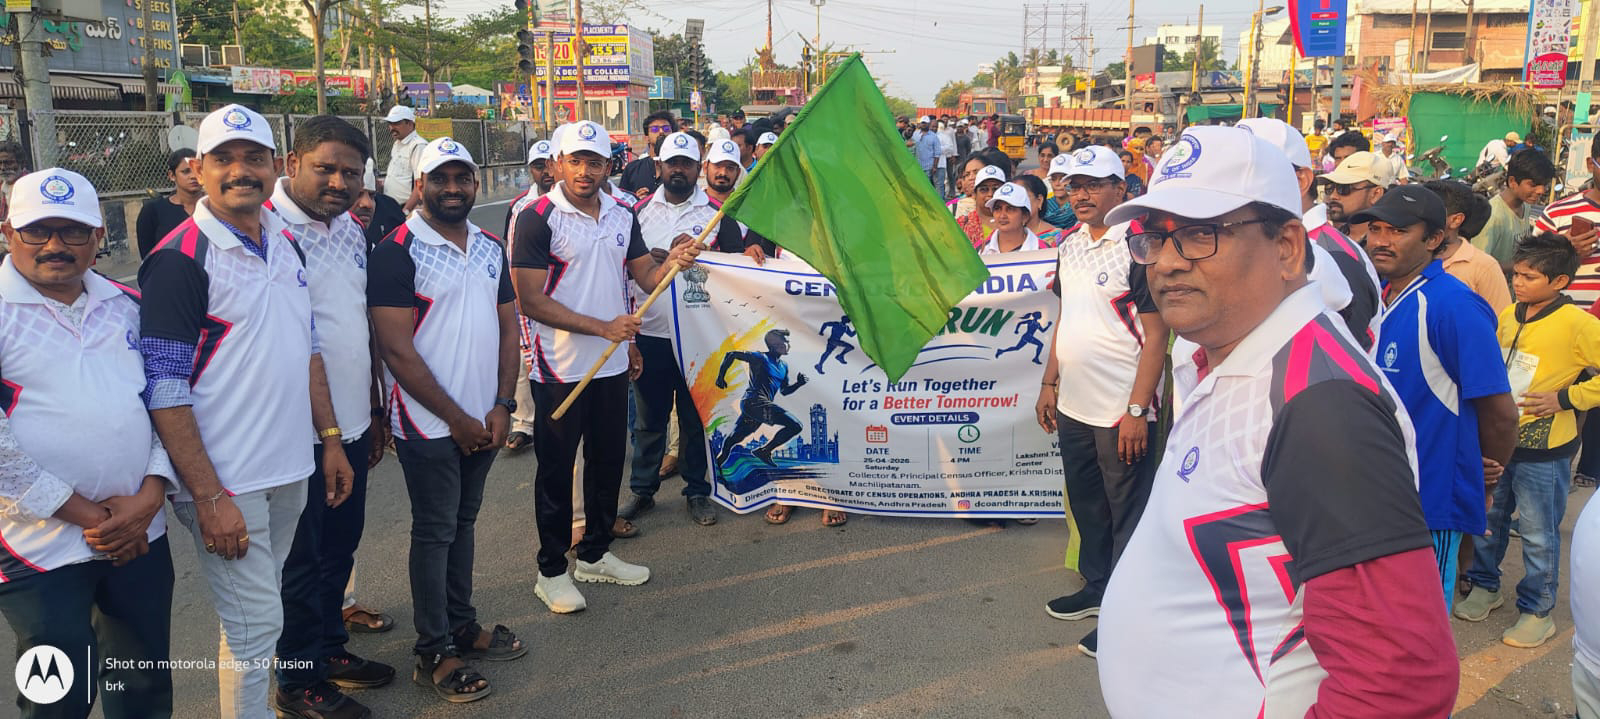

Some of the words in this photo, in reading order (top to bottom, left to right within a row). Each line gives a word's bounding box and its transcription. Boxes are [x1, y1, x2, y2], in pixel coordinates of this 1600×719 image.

[135, 0, 170, 13] SEETS
[785, 280, 838, 296] CEN
[938, 307, 1015, 336] RUN
[842, 379, 882, 393] Let's
[886, 379, 918, 392] Run
[923, 378, 997, 394] Together
[842, 397, 866, 410] for
[869, 399, 878, 410] a
[883, 396, 933, 409] Better
[936, 393, 1019, 409] Tomorrow!
[894, 415, 926, 423] EVENT
[928, 414, 970, 422] DETAILS
[1015, 451, 1049, 459] Lakshmi
[865, 464, 900, 472] Saturday
[900, 472, 939, 480] Principal
[974, 470, 1008, 478] Officer,
[1009, 468, 1043, 476] Krishna
[805, 485, 853, 496] DIRECTORATE
[849, 481, 922, 489] Machilipatanam.
[745, 487, 787, 502] Directorate
[798, 490, 828, 500] Census
[974, 500, 1062, 508] dcoandhrapradesh
